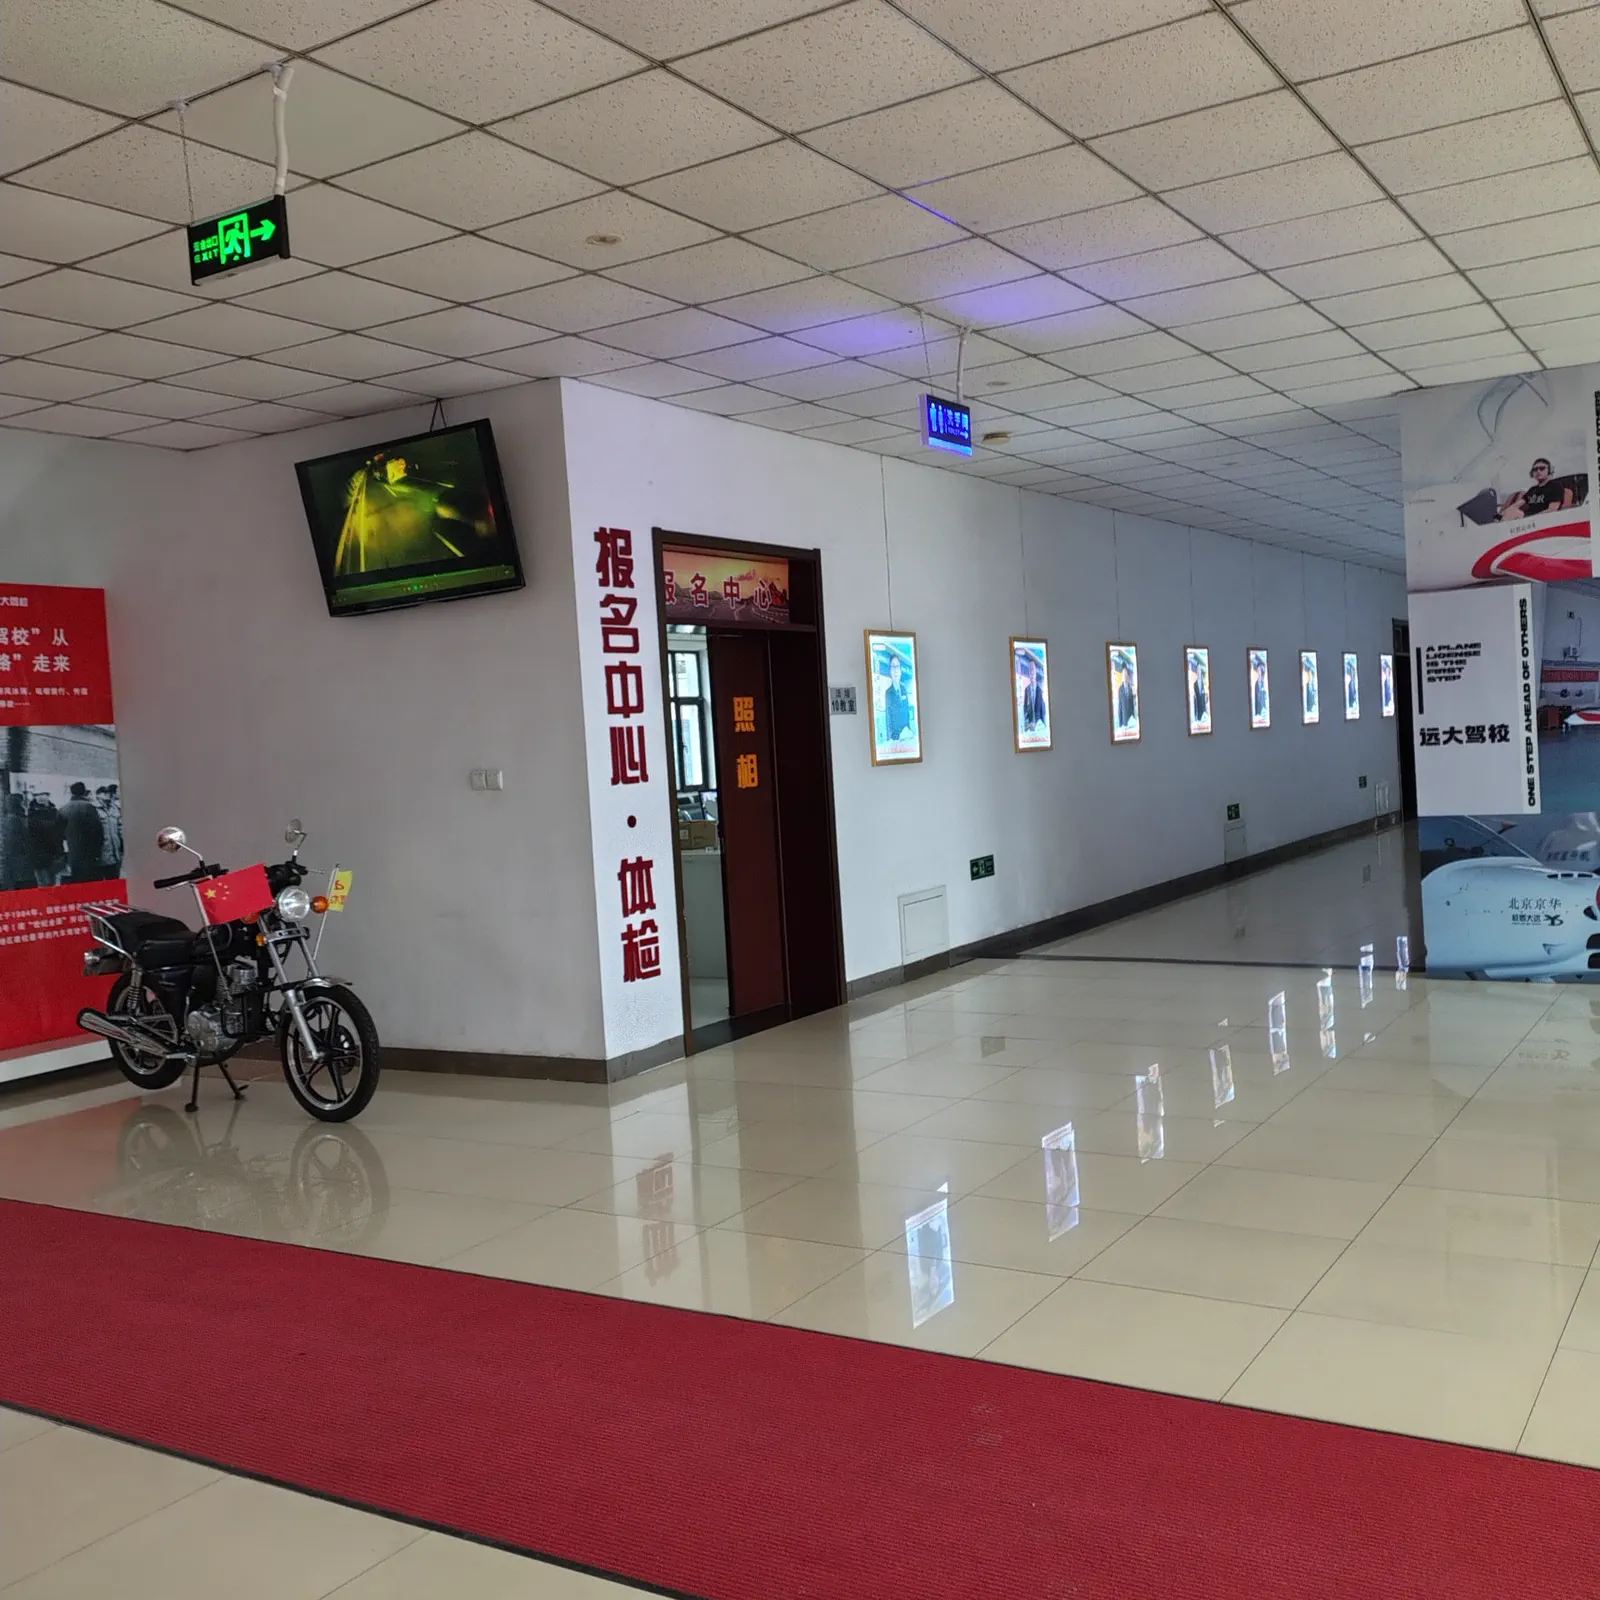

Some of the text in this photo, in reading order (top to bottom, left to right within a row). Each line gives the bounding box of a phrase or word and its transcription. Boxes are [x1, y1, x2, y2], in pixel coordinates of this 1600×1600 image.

[194, 248, 219, 263] EXIT
[1438, 642, 1481, 651] PLANE
[1427, 675, 1461, 683] STEP
[1519, 598, 1536, 807] ONE STEP AHEAD OF OTHERS
[733, 697, 758, 788] 照相
[1420, 724, 1510, 746] 远大驾校
[1508, 897, 1562, 911] 北京京华
